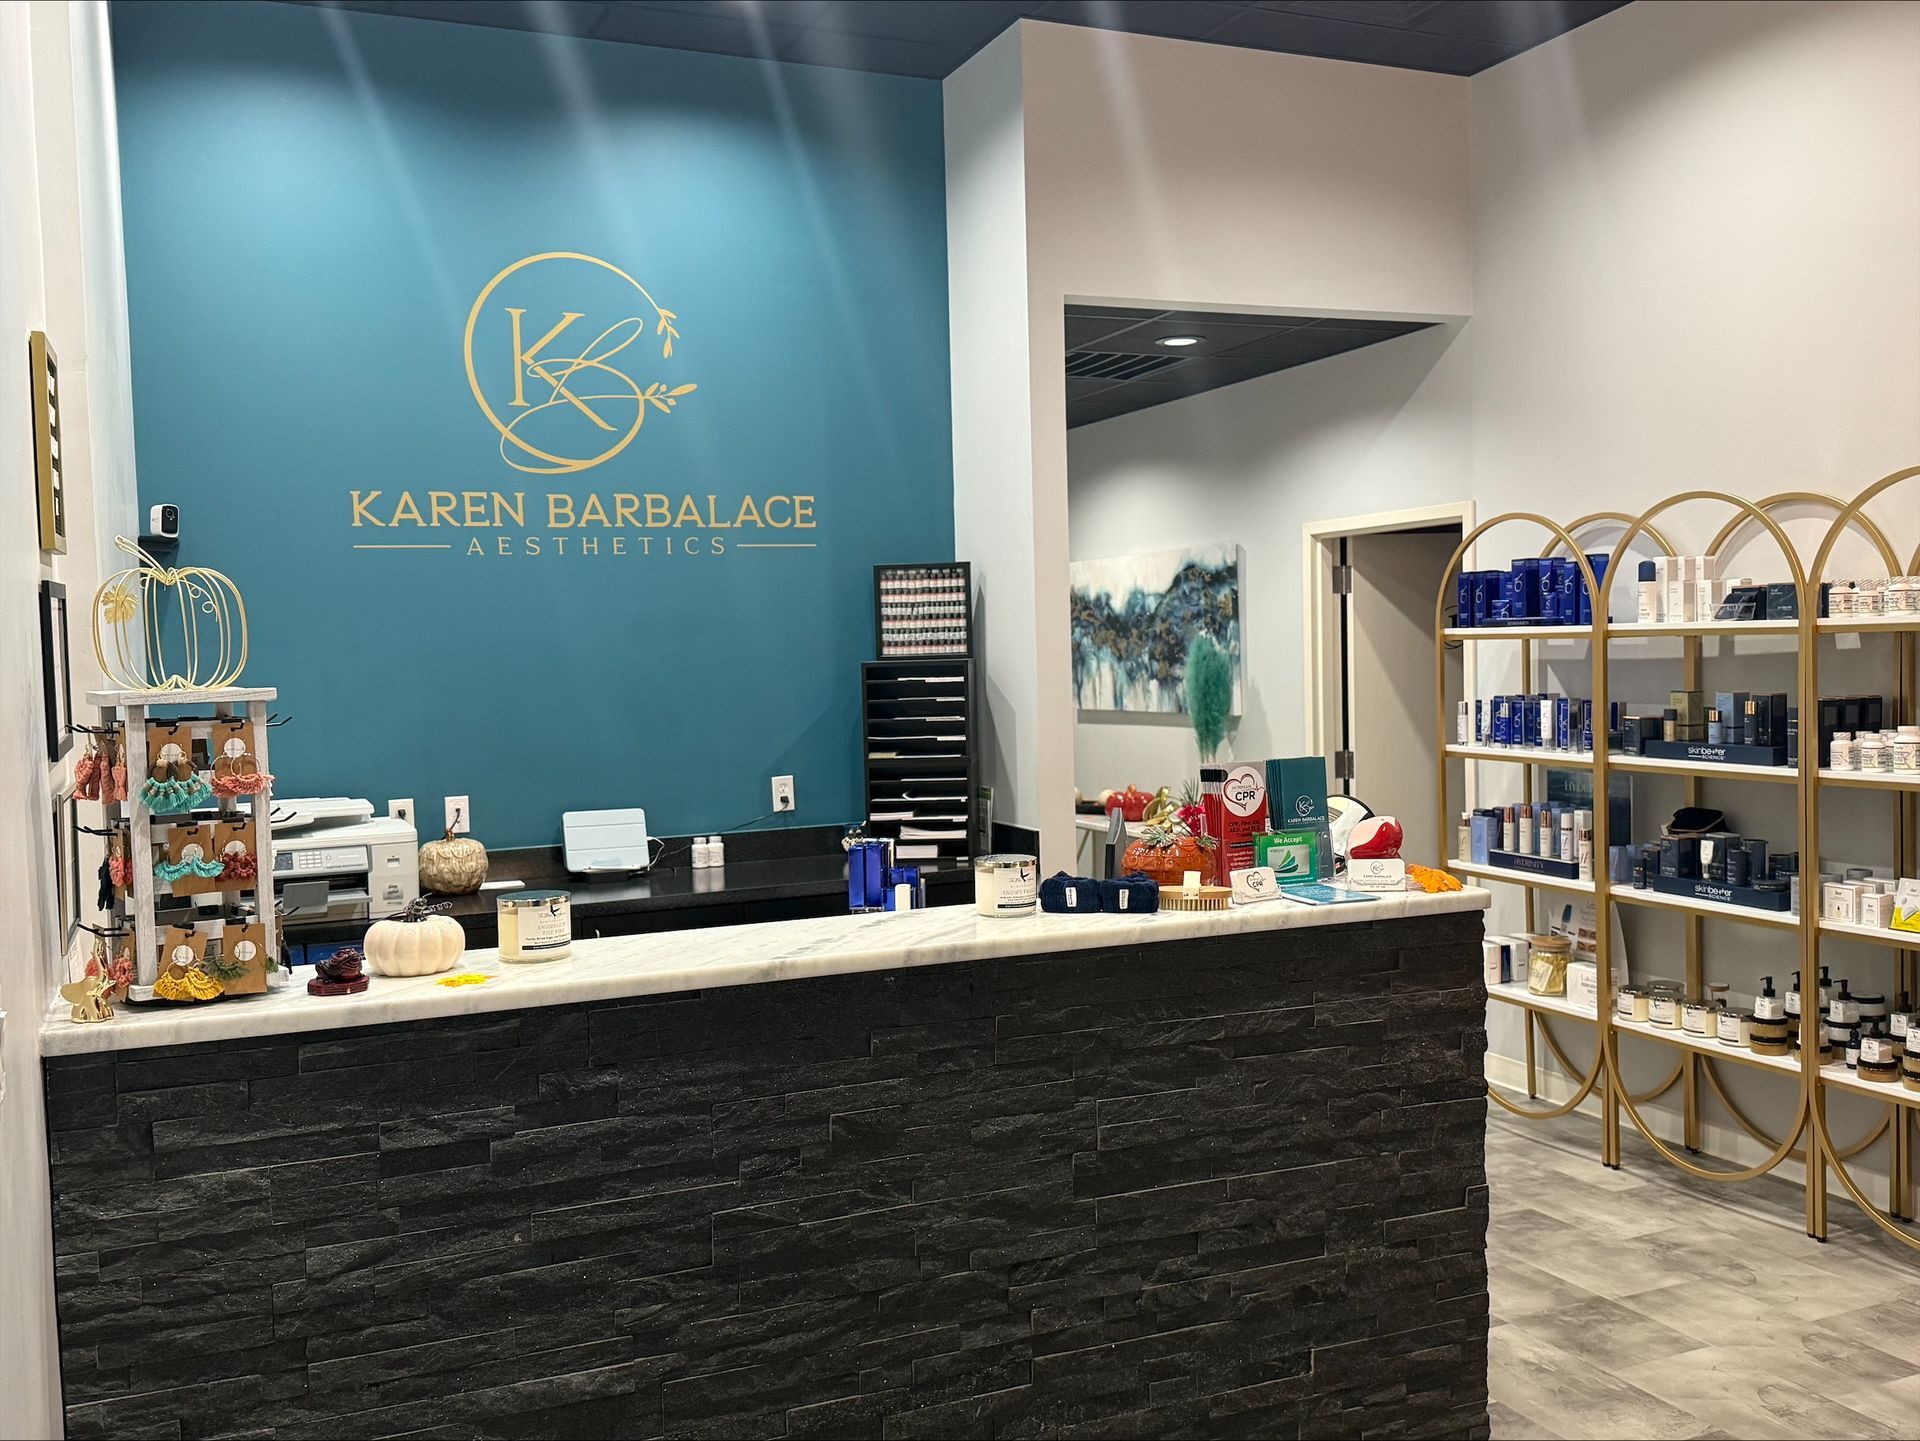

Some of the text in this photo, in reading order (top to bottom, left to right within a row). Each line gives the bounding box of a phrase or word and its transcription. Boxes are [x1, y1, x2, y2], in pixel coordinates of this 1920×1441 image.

[350, 490, 817, 528] KAREN BARBALACE
[466, 536, 726, 556] AESTHETICS
[1235, 791, 1256, 801] CPR
[1284, 835, 1303, 844] Accept
[1252, 880, 1264, 888] CPR
